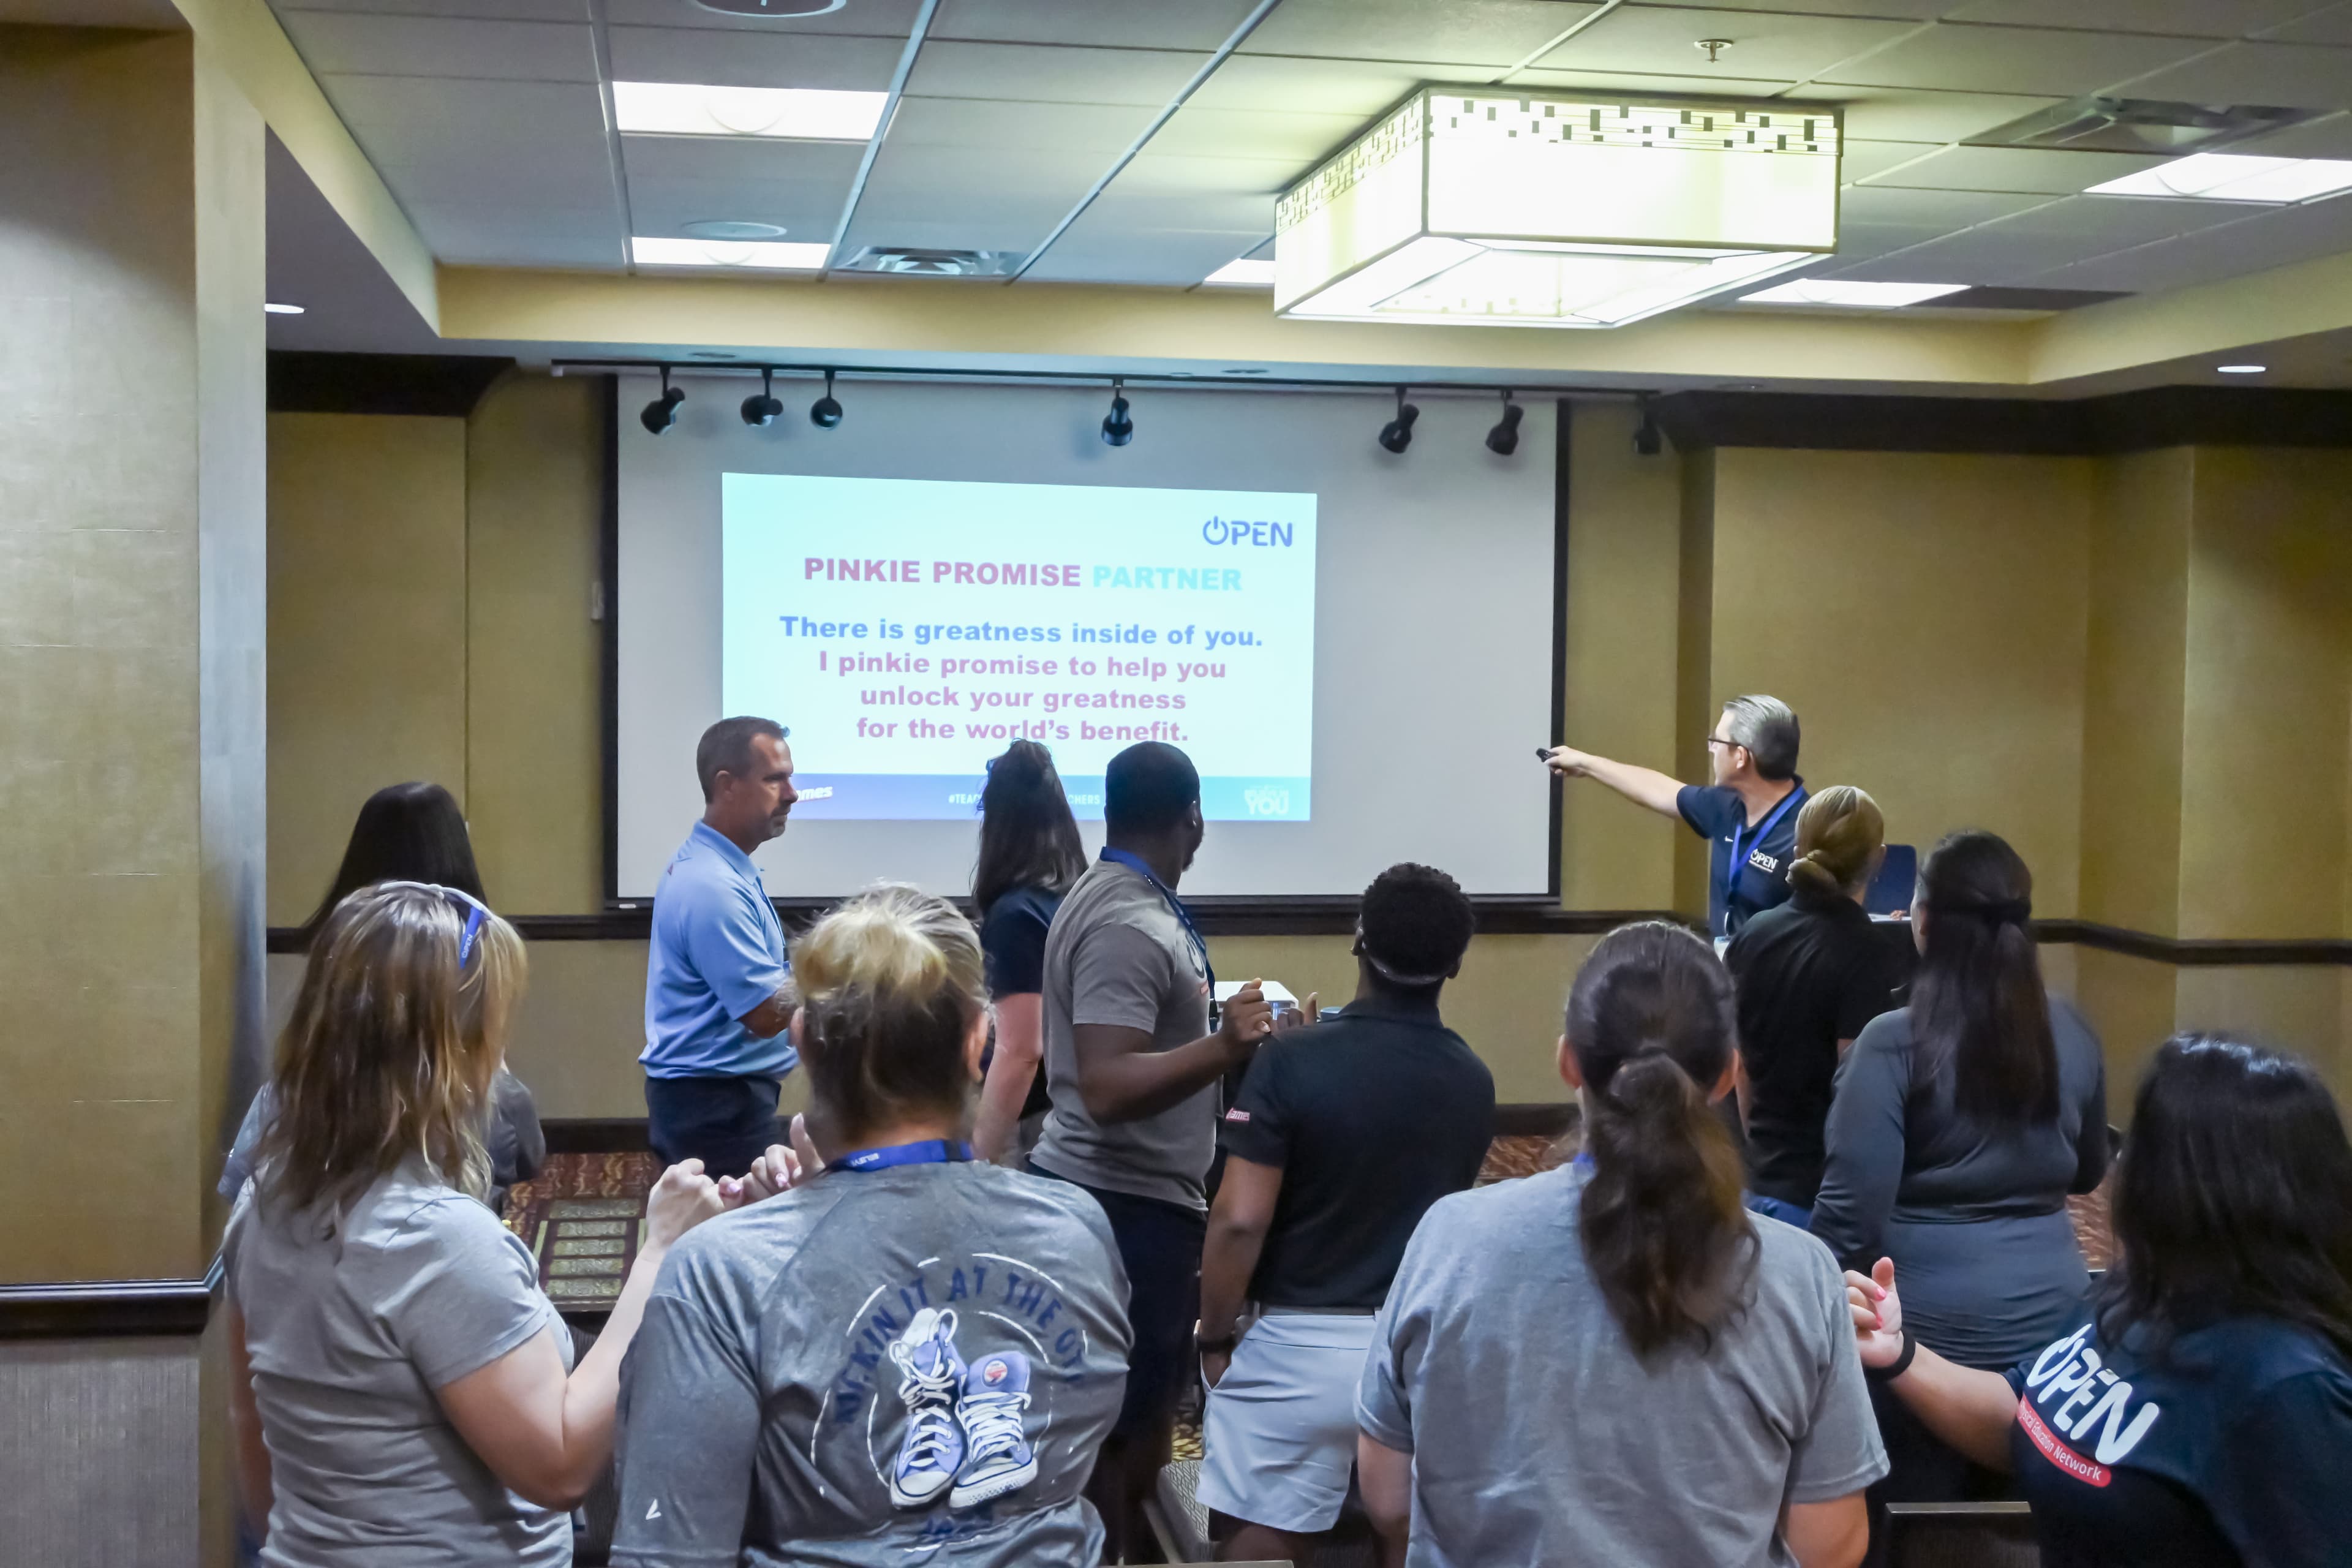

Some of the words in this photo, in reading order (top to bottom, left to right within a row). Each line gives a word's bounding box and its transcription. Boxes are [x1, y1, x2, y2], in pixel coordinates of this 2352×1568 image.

[1202, 515, 1293, 547] OPEN
[804, 557, 921, 582] PINKIE
[933, 561, 1081, 587] PROMISE
[1093, 565, 1242, 591] PARTNER
[779, 616, 868, 638] There
[880, 618, 903, 639] is
[914, 621, 1061, 645] greatness
[1072, 623, 1156, 644] inside
[1167, 624, 1195, 644] of
[1205, 630, 1262, 650] you.
[820, 650, 827, 671] I
[839, 651, 930, 676] pinkie
[941, 654, 1058, 679] promise
[1069, 657, 1096, 676] to
[1107, 657, 1167, 682] help
[1177, 662, 1226, 682] you
[861, 685, 959, 706] unlock
[970, 691, 1034, 712] your
[1043, 689, 1186, 713] greatness
[857, 717, 899, 738] for
[908, 718, 956, 739] the
[1080, 720, 1188, 741] benefit.
[1750, 848, 1777, 869] OPEN
[947, 1265, 987, 1302] AT
[1003, 1272, 1062, 1329] THE
[2026, 1324, 2159, 1464] OPEN
[2053, 1446, 2102, 1480] Network
